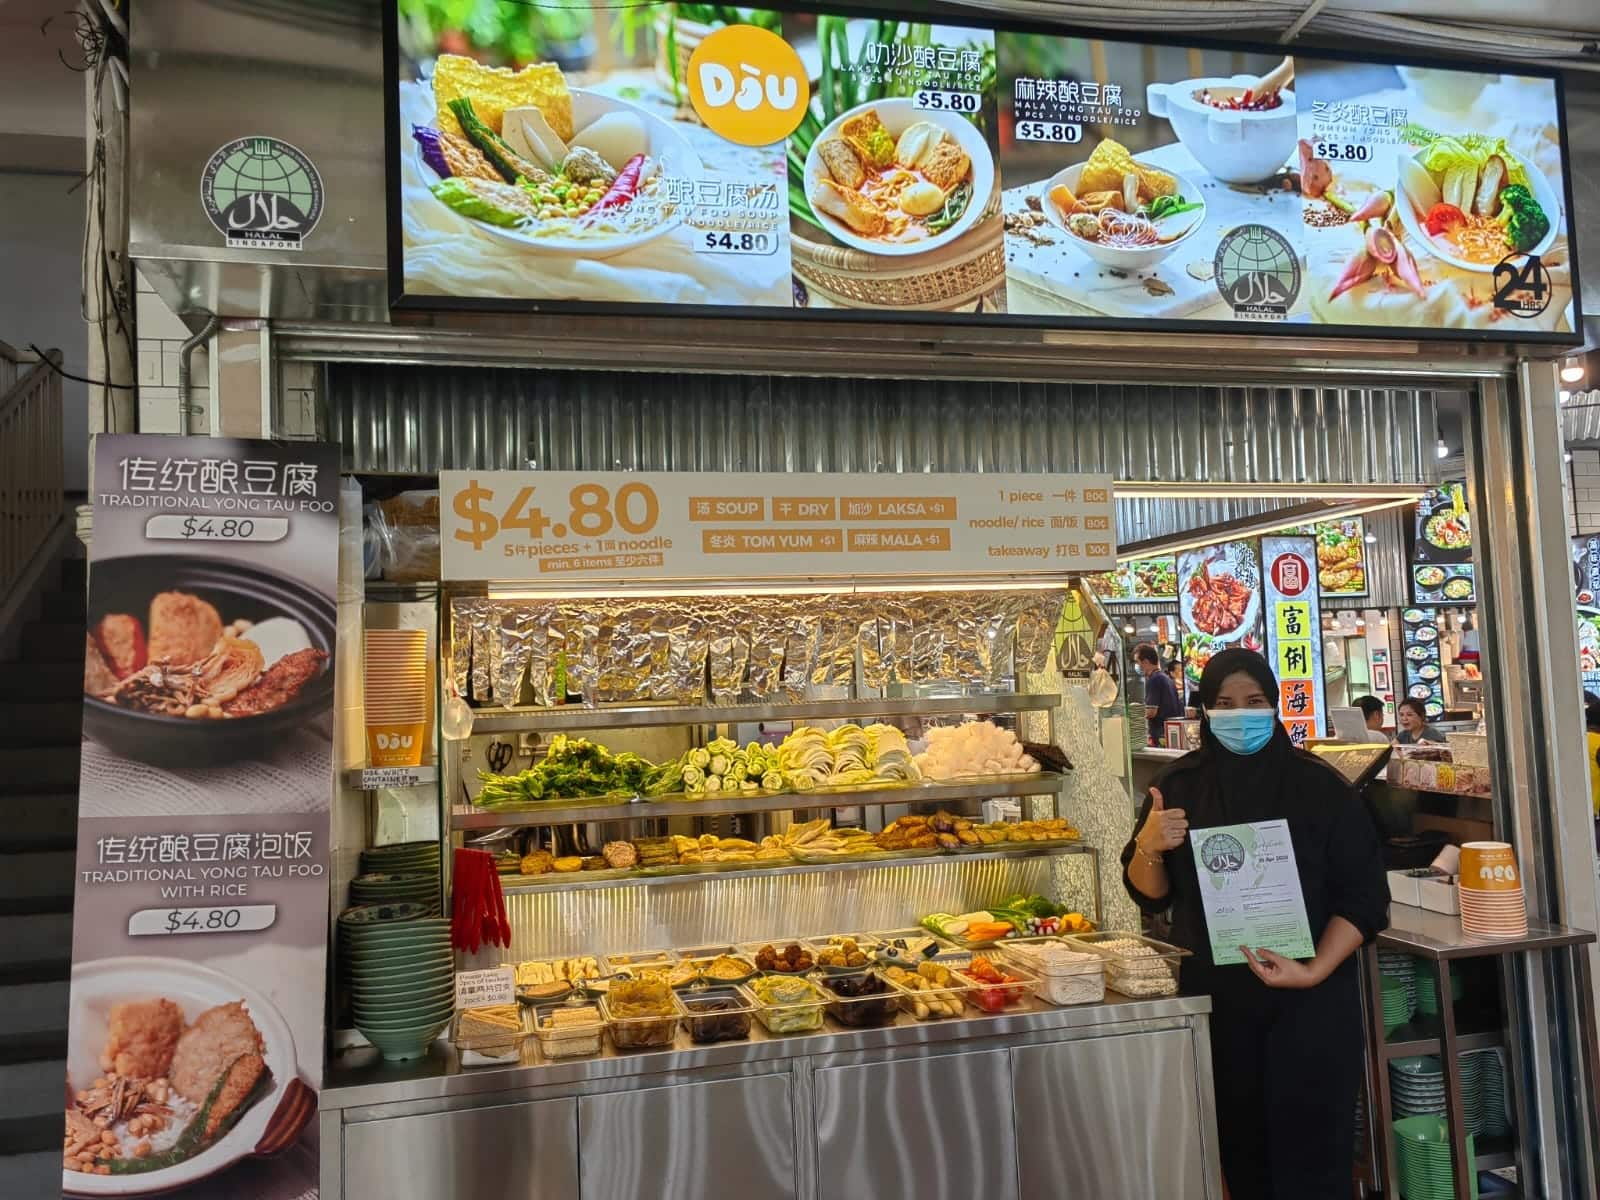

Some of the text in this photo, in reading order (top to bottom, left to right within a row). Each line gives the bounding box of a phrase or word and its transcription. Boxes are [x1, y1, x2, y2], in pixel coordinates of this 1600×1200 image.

[867, 41, 980, 72] 叻沙酿豆腐
[928, 71, 949, 79] TAU
[957, 73, 980, 82] FOO
[1015, 78, 1122, 106] 麻辣酿豆腐
[919, 92, 976, 111] $5.80
[1015, 101, 1141, 117] MALA YONG TAU FOO
[1068, 115, 1137, 126] NOODLE/RICE
[1021, 122, 1076, 141] $5.80
[1318, 142, 1367, 160] $5.80
[664, 177, 779, 210] 酿豆腐汤
[663, 206, 692, 216] TAU
[701, 209, 730, 218] FOO
[739, 211, 777, 220] SOUP
[245, 231, 283, 239] HALAL
[705, 231, 769, 251] $4.80
[228, 240, 301, 249] SINGAPORE
[1493, 255, 1547, 308] 24
[119, 457, 319, 497] 传统酿豆腐
[100, 494, 334, 513] TRADITIONAL YONG TAU FOO
[1008, 489, 1044, 503] piece
[452, 479, 660, 551] $4.80
[716, 502, 759, 514] SOUP
[798, 503, 829, 516] DRY
[878, 503, 927, 516] LAKSA
[181, 515, 255, 540] $4.80
[1021, 517, 1045, 528] rice
[742, 535, 775, 548] TOM
[779, 535, 813, 548] YUM
[881, 534, 923, 546] MALA
[988, 544, 1050, 559] takeaway
[581, 557, 612, 568] items
[97, 831, 313, 864] 传统酿豆腐泡饭
[82, 864, 323, 883] TRADITIONAL YONG TAU FOO
[160, 883, 248, 898] WITH RICE
[165, 908, 241, 935] $4.80
